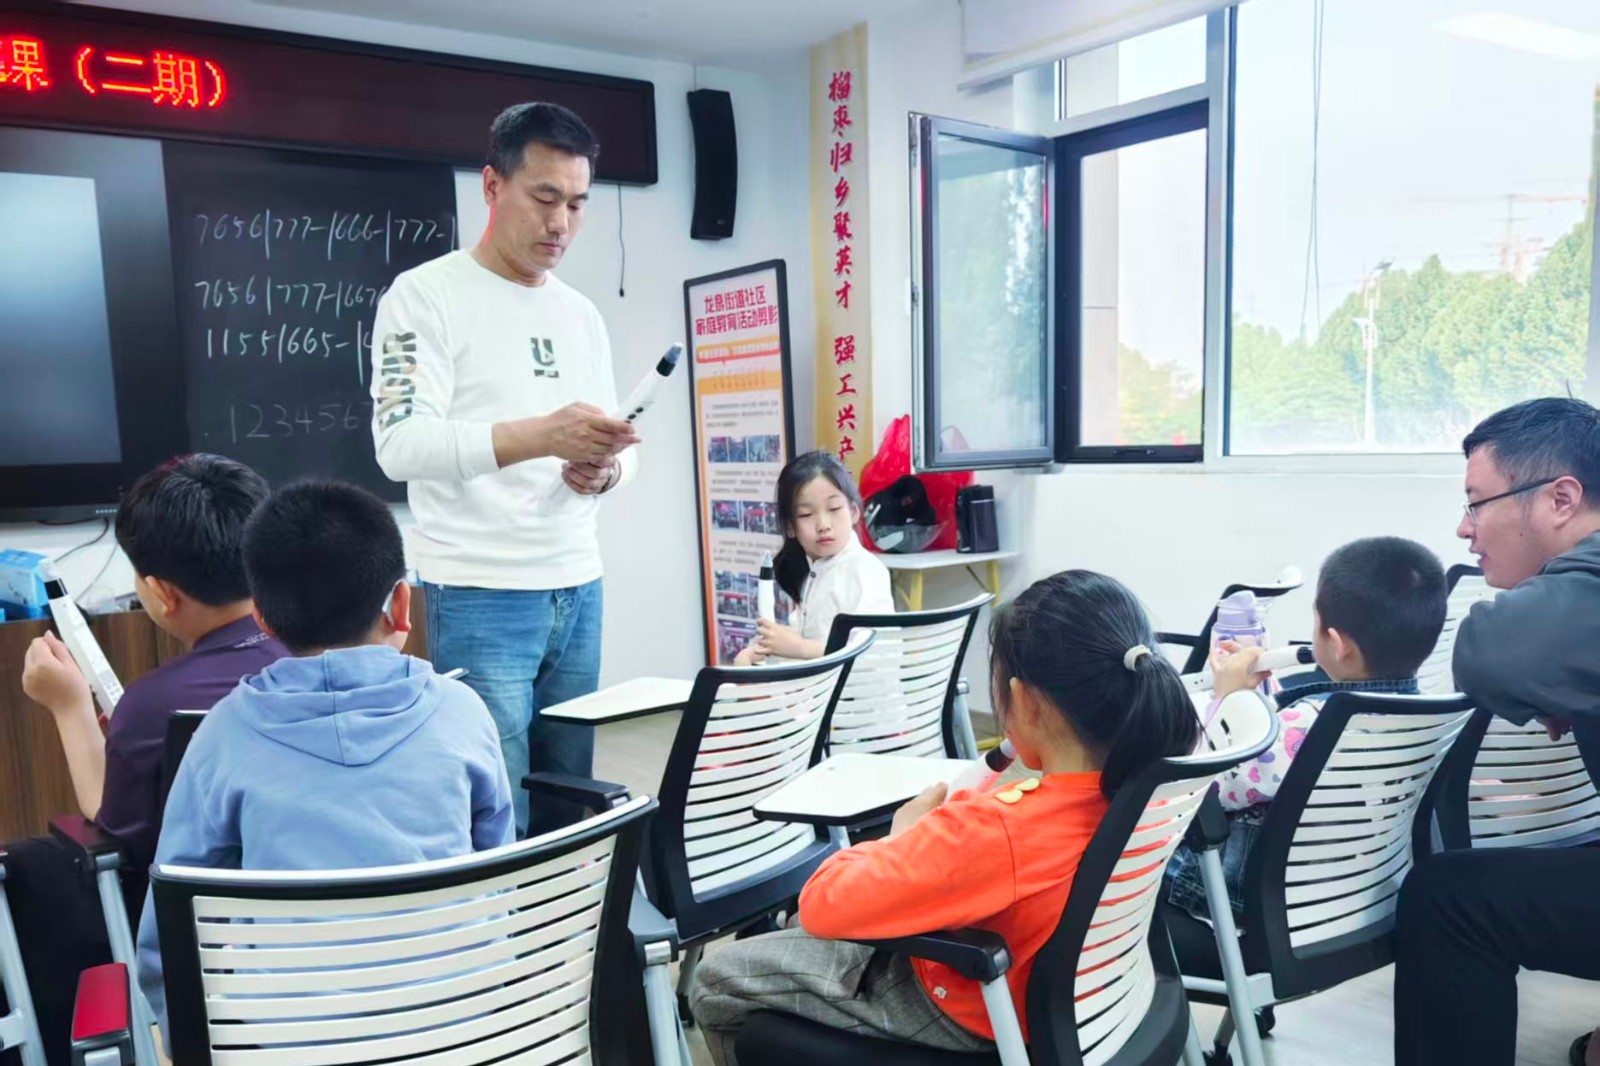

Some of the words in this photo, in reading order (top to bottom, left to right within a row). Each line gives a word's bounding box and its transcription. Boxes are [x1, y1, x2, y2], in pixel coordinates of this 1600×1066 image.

[828, 71, 853, 310] 榴枣归乡聚英才
[695, 304, 778, 336] 家庭教育活动剪影
[230, 401, 374, 445] 123456
[834, 335, 857, 476] 强工兴产
